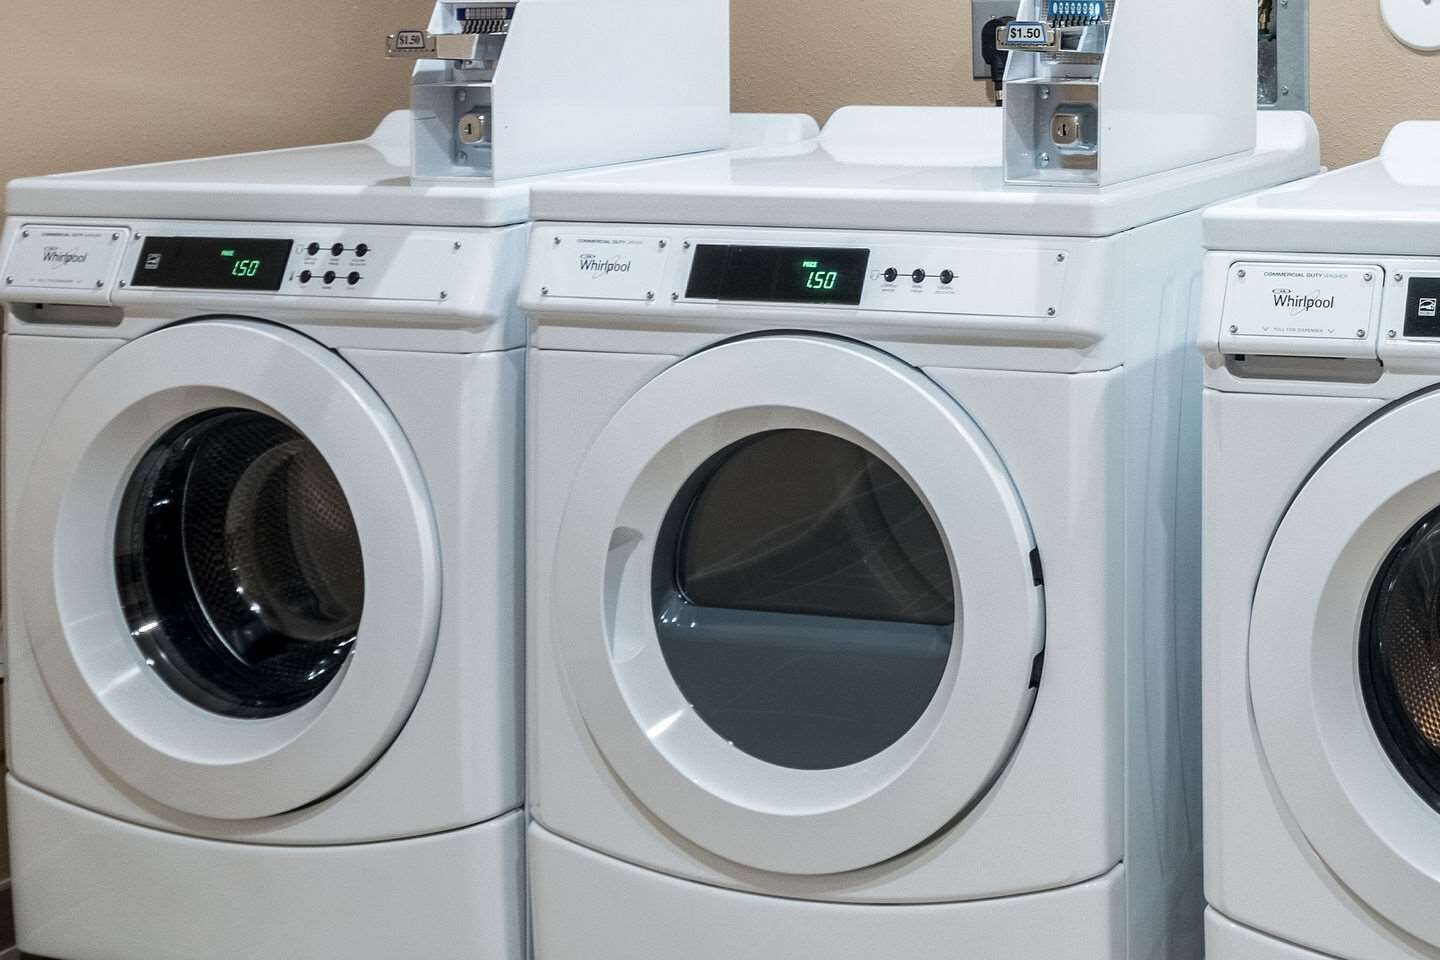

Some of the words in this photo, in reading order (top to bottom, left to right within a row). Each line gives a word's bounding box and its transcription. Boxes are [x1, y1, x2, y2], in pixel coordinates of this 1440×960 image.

[1010, 27, 1041, 39] $1.50
[232, 260, 260, 276] 1.50
[580, 259, 631, 274] Whirlpool
[806, 271, 837, 289] 1.50
[1273, 294, 1334, 312] Whirlpool
